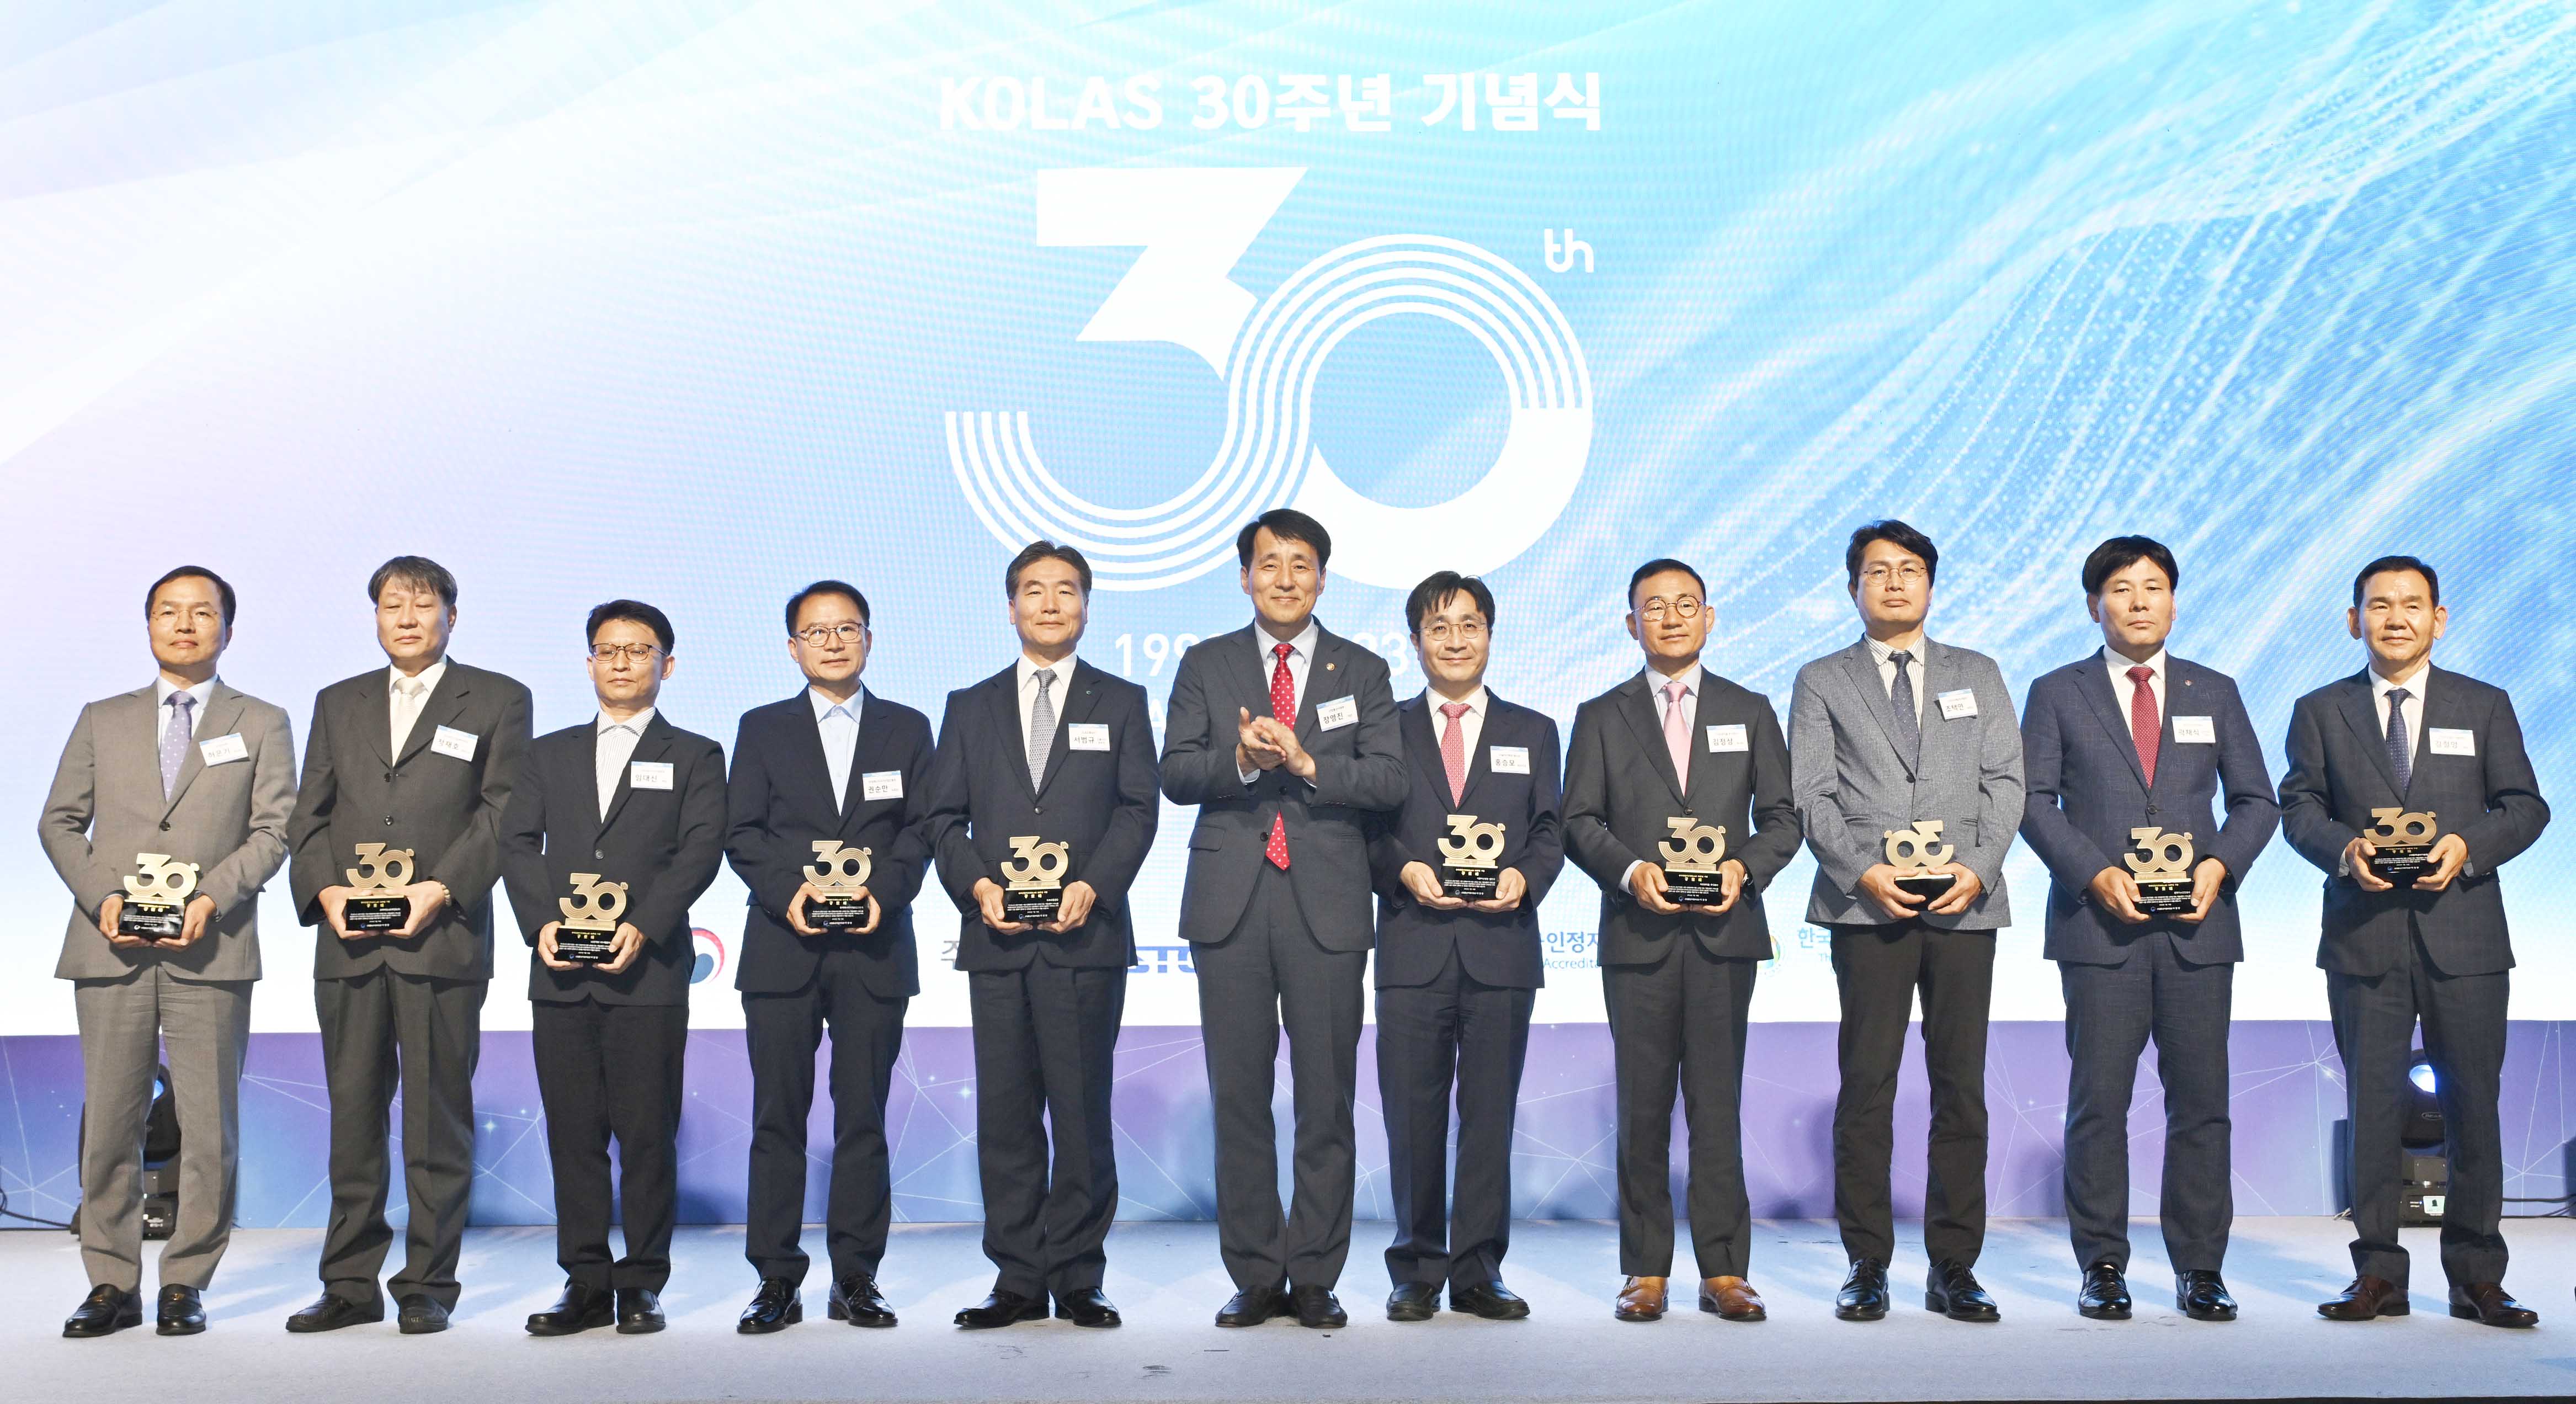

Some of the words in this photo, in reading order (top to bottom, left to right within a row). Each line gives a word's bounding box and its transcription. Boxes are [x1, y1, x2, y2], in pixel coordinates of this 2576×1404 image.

[939, 75, 1163, 131] KOLAS
[1190, 73, 1391, 132] 30주년
[1421, 72, 1600, 131] 기념식
[1115, 633, 1224, 677] 19
[1323, 712, 1343, 724] 장영진
